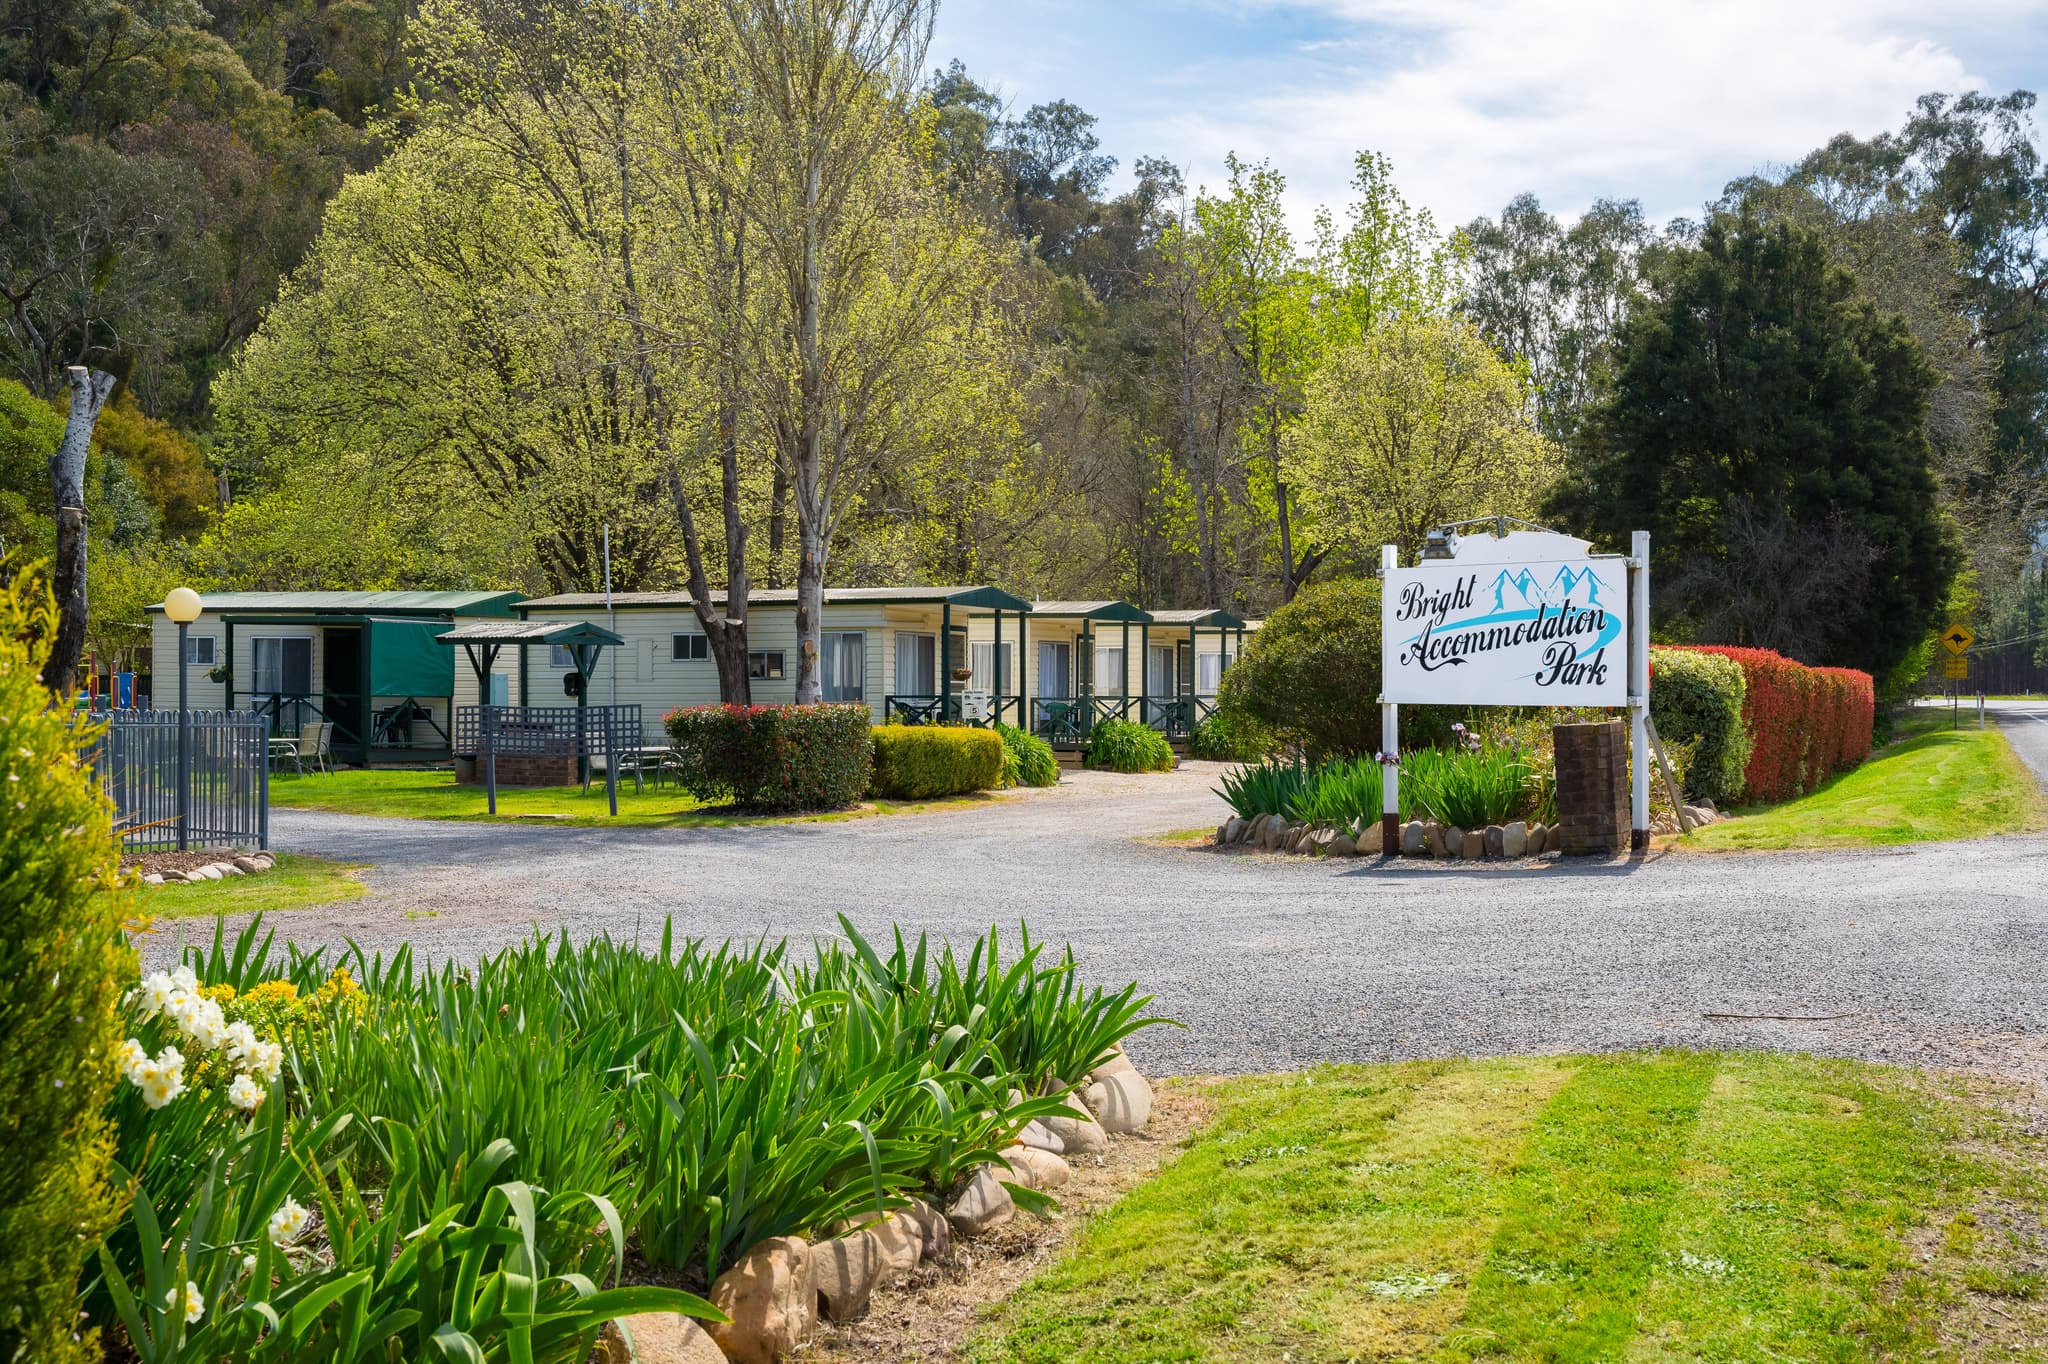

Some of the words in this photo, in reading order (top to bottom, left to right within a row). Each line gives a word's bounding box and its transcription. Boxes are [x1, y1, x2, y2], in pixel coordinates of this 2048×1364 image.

[1396, 574, 1477, 626] Bright
[1400, 599, 1607, 671] Accommodation
[1535, 640, 1608, 687] Park
